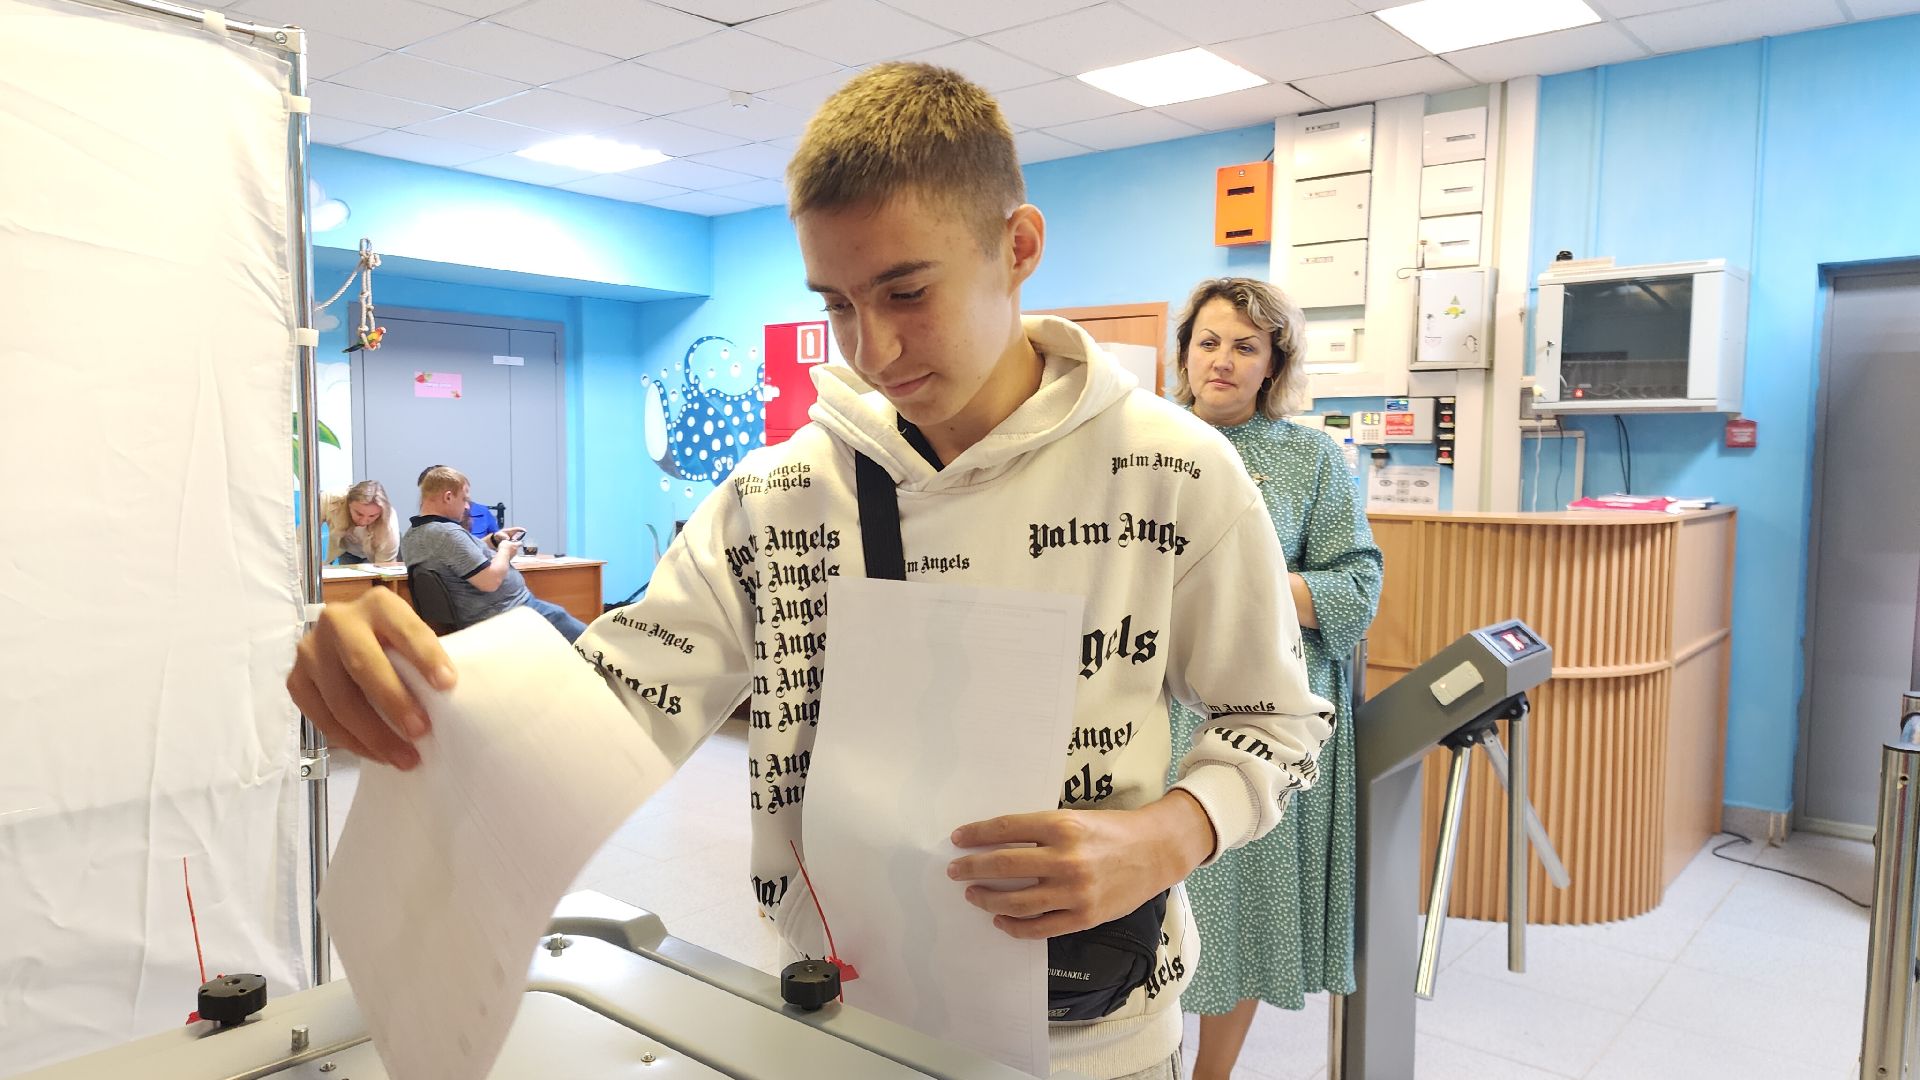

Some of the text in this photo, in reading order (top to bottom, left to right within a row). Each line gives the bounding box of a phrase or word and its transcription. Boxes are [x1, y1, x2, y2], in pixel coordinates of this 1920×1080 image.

[1152, 452, 1201, 479] Angels
[764, 523, 841, 557] Angels
[1117, 512, 1190, 556] Angs
[921, 553, 970, 574] Angels
[772, 592, 828, 629] Angel
[647, 622, 695, 654] Angels
[774, 632, 827, 665] Ange
[1079, 615, 1160, 680] gels
[1067, 721, 1138, 757] Angel
[1047, 967, 1091, 981] IUXIANXILIE
